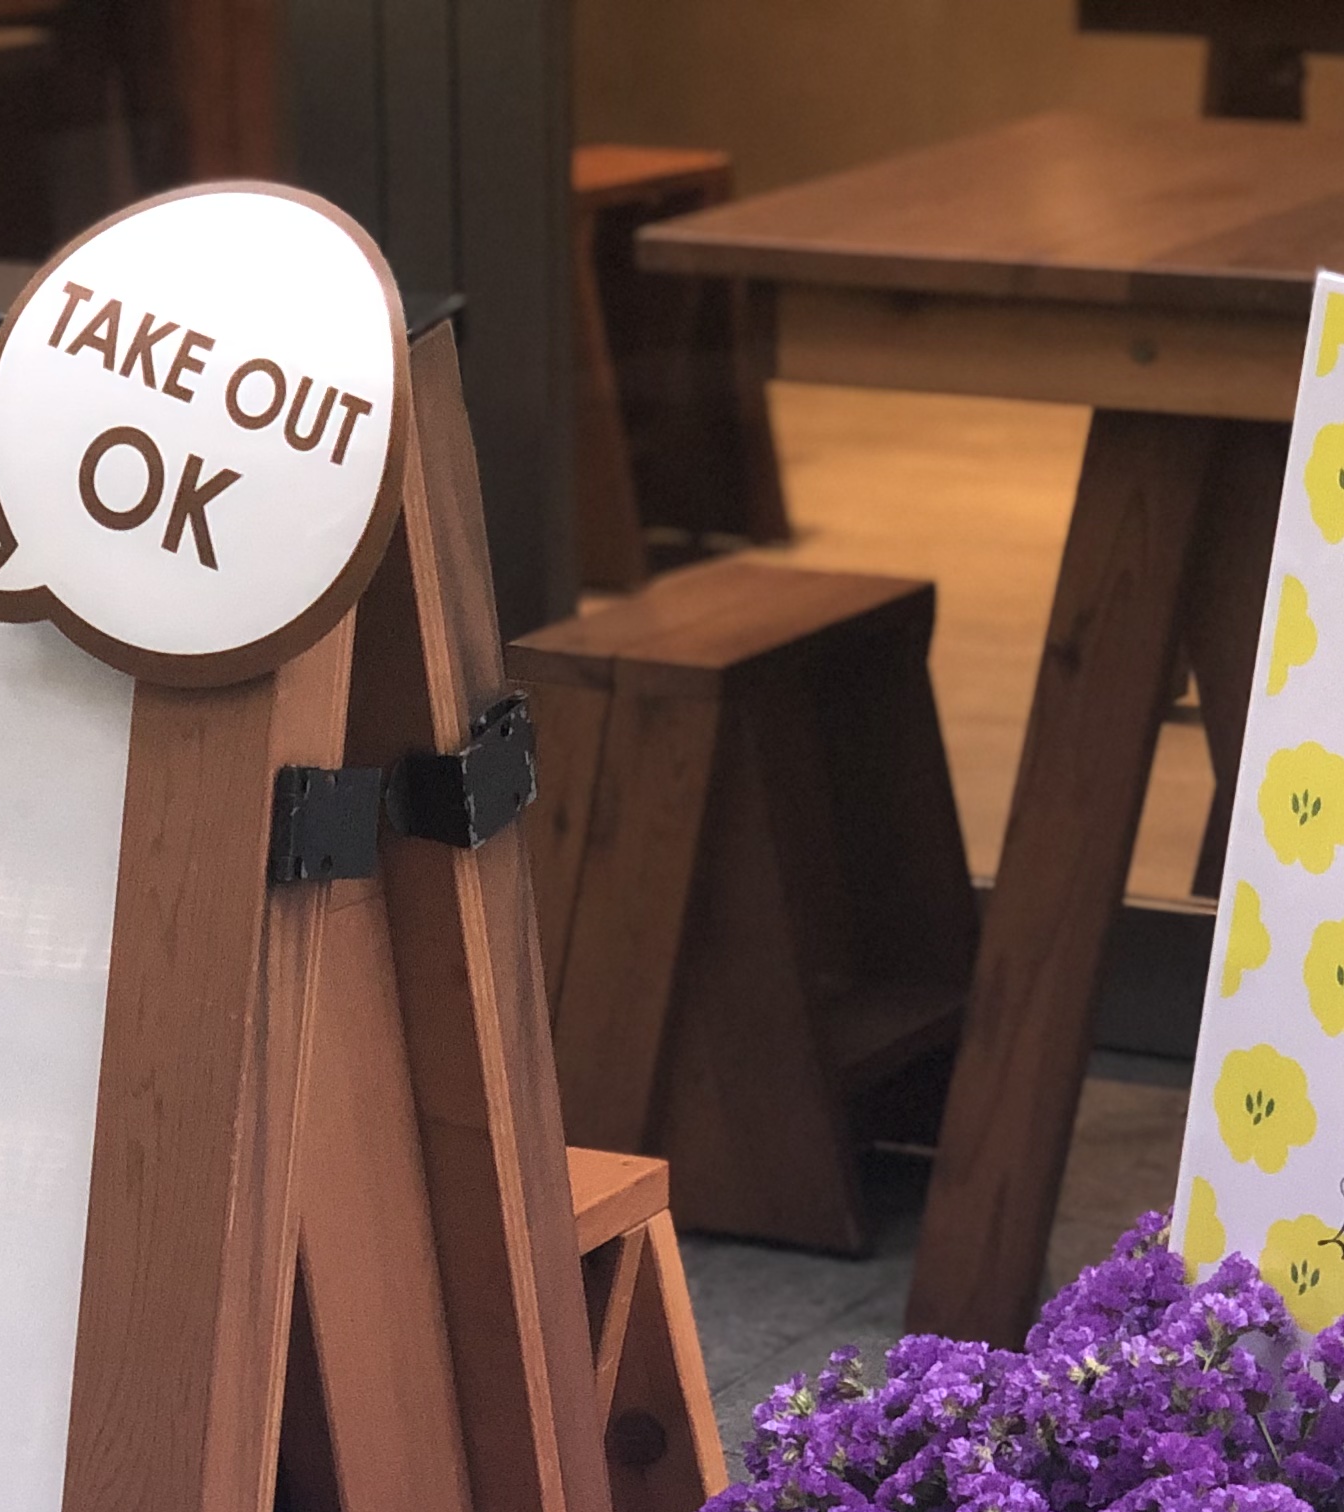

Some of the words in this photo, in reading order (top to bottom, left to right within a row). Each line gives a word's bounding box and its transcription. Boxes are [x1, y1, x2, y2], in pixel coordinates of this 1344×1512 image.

[47, 281, 216, 404] TAKE
[224, 357, 373, 465] OUT
[79, 425, 243, 571] OK
